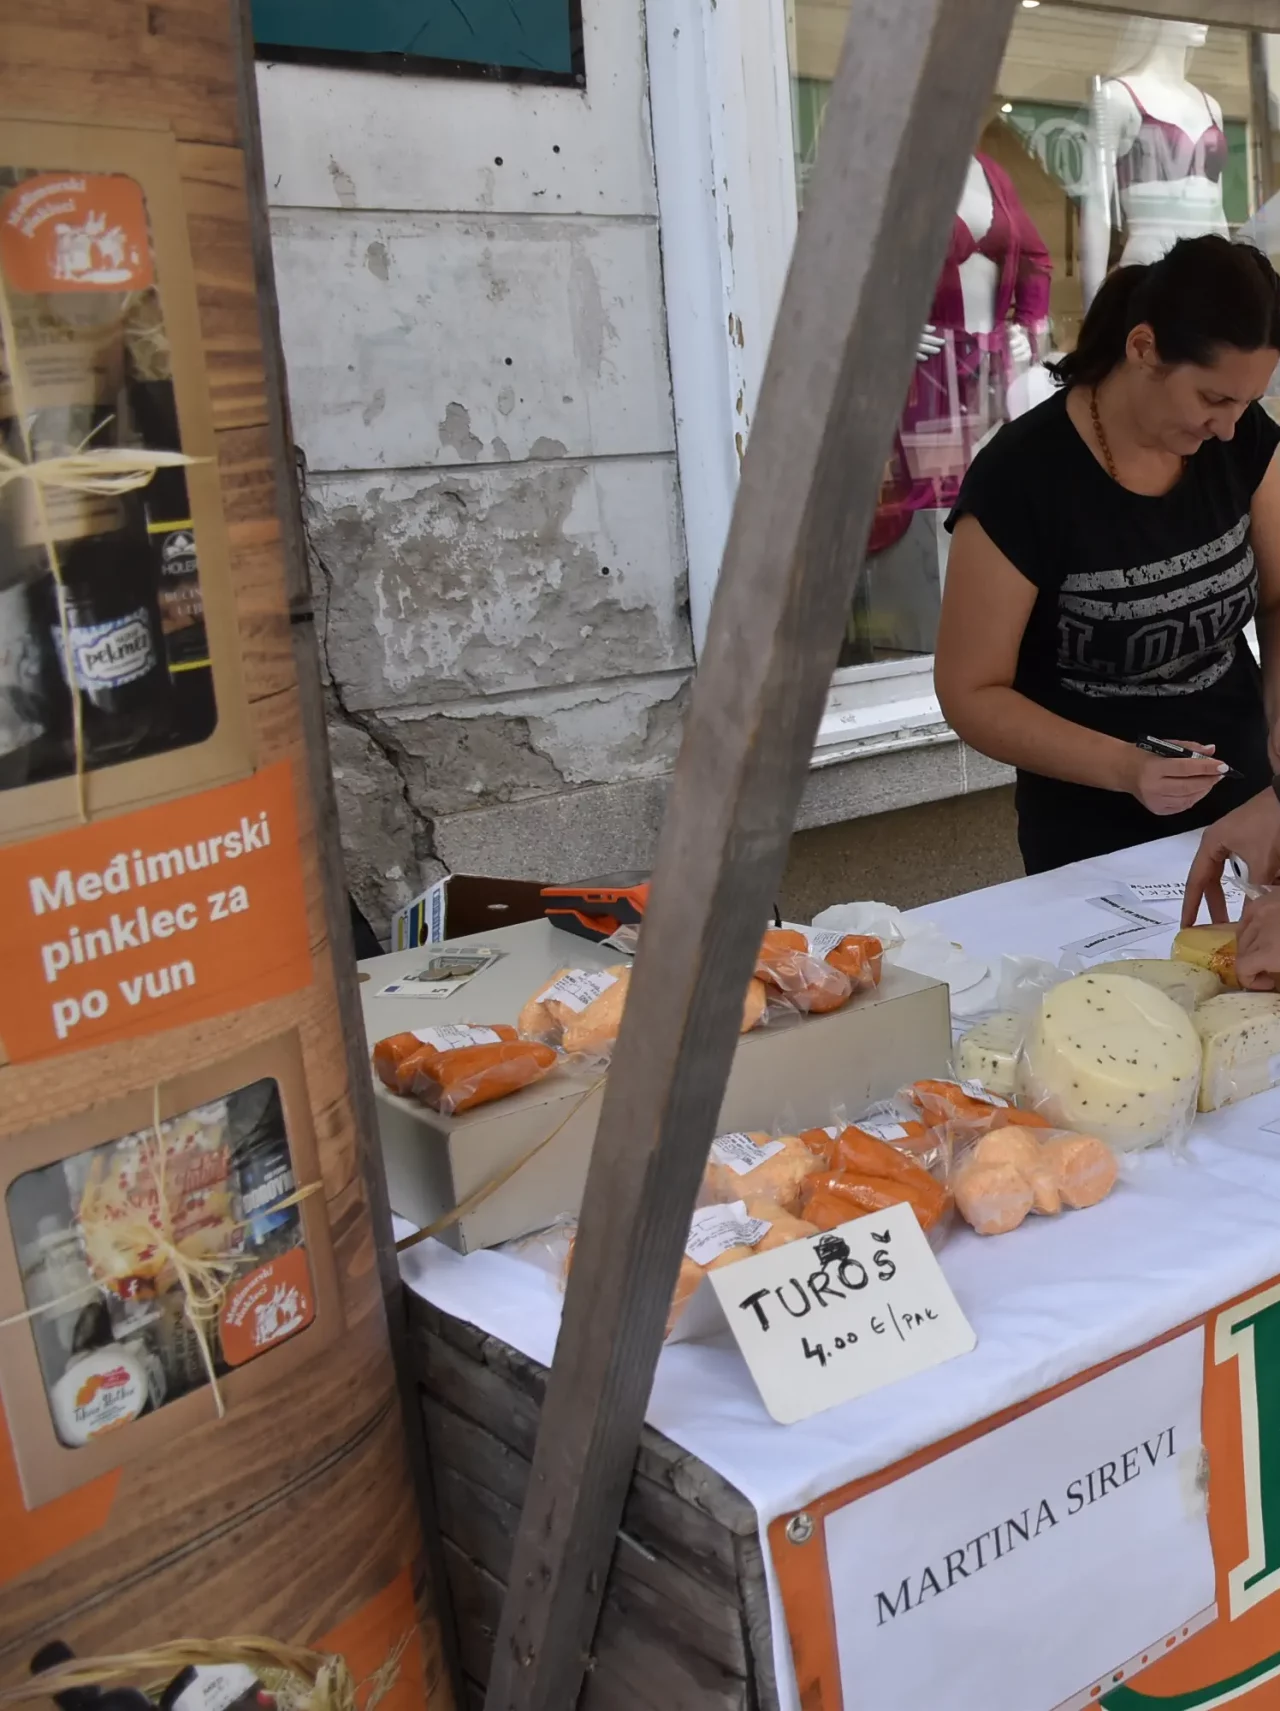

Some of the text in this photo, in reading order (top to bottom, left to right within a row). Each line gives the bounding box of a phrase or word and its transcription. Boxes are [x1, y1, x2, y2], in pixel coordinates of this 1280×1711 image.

[29, 811, 271, 916] Međimurski
[41, 884, 250, 983] pinklec za
[52, 959, 196, 1040] po vun
[739, 1229, 897, 1332] TUROŠ
[801, 1332, 859, 1367] 4.00
[873, 1425, 1177, 1627] MARTINA SIREVI
